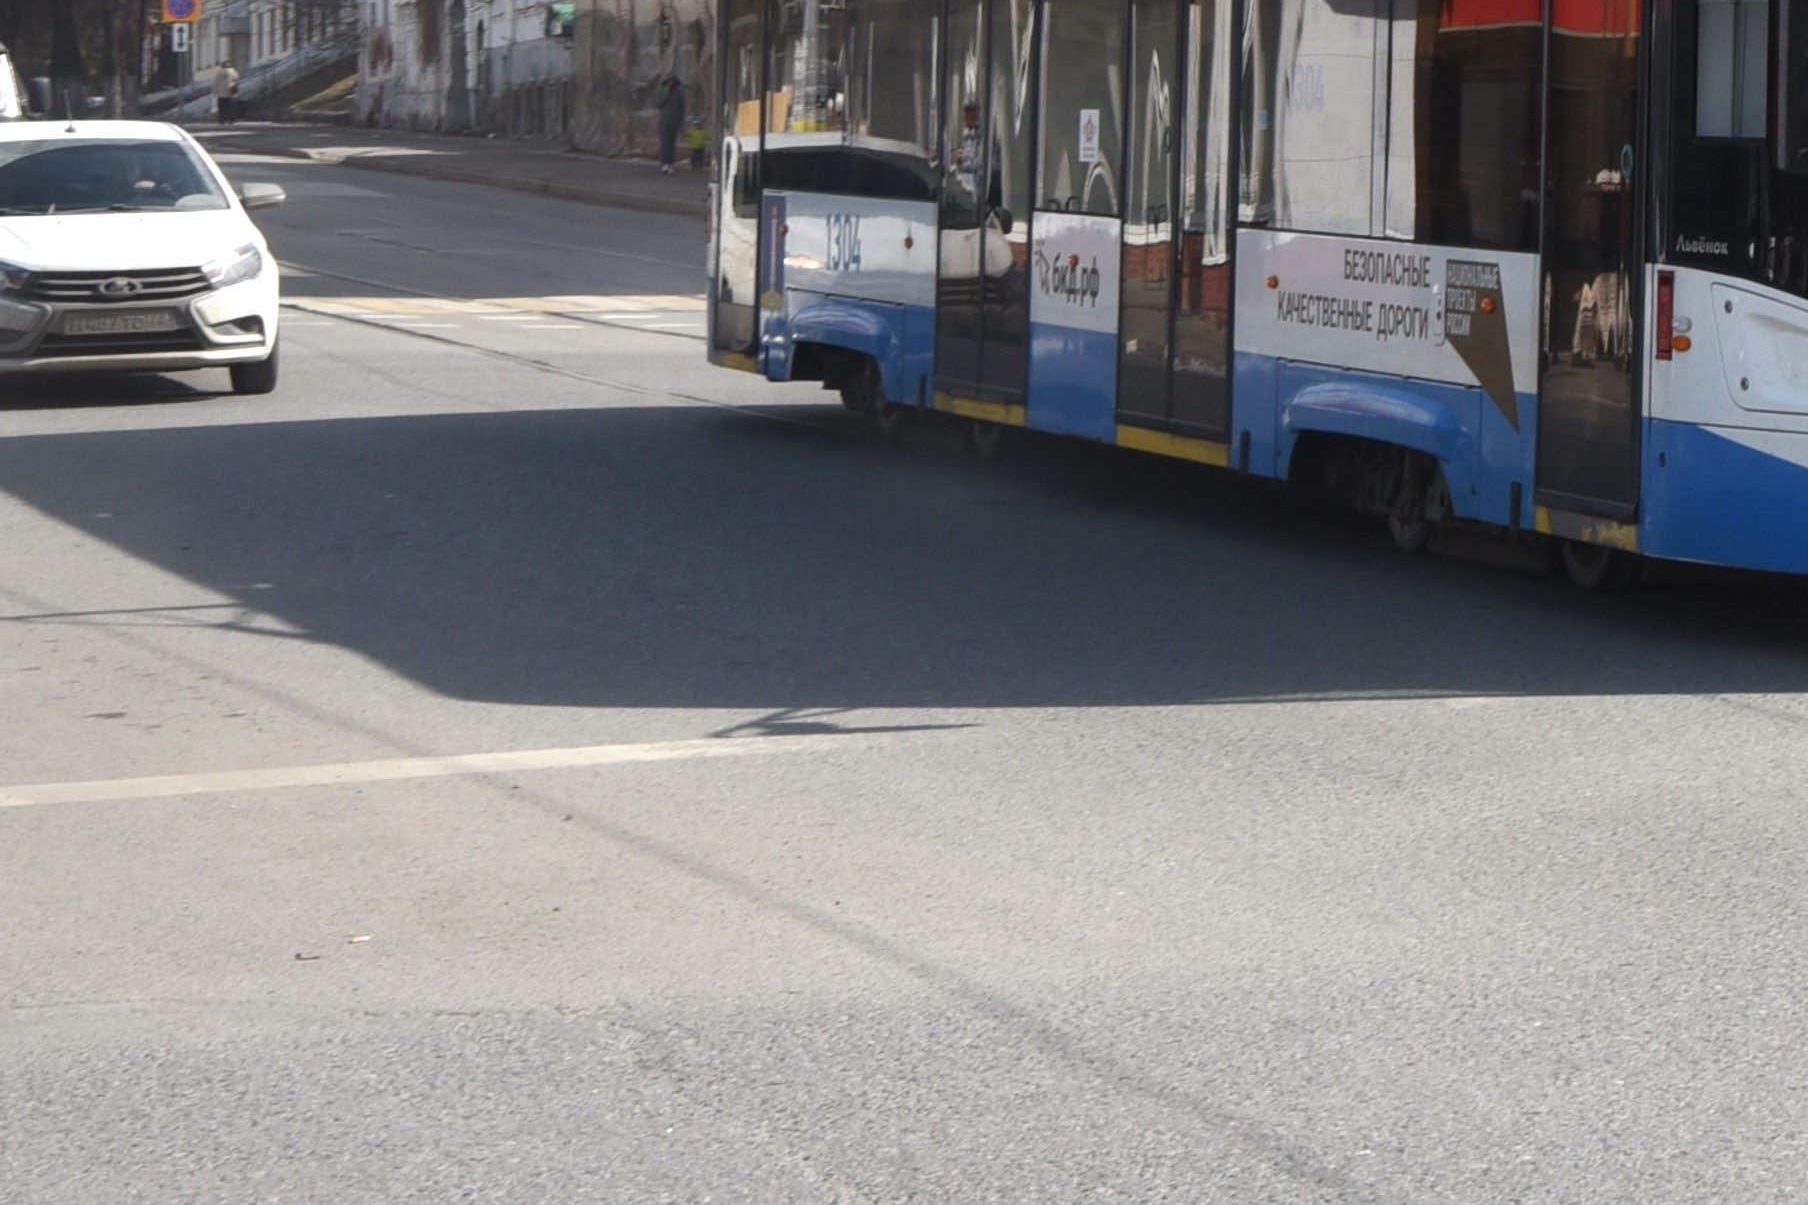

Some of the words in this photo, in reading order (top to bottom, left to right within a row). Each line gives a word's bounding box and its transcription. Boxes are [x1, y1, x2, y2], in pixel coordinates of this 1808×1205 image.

[826, 212, 862, 274] 1304
[1676, 234, 1729, 256] Львёнок
[1344, 249, 1431, 288] БЕЗОПАСНЫЕ
[1277, 291, 1373, 332] КАЧЕСТВЕННЫЕ
[1376, 304, 1429, 342] ДОРОГИ
